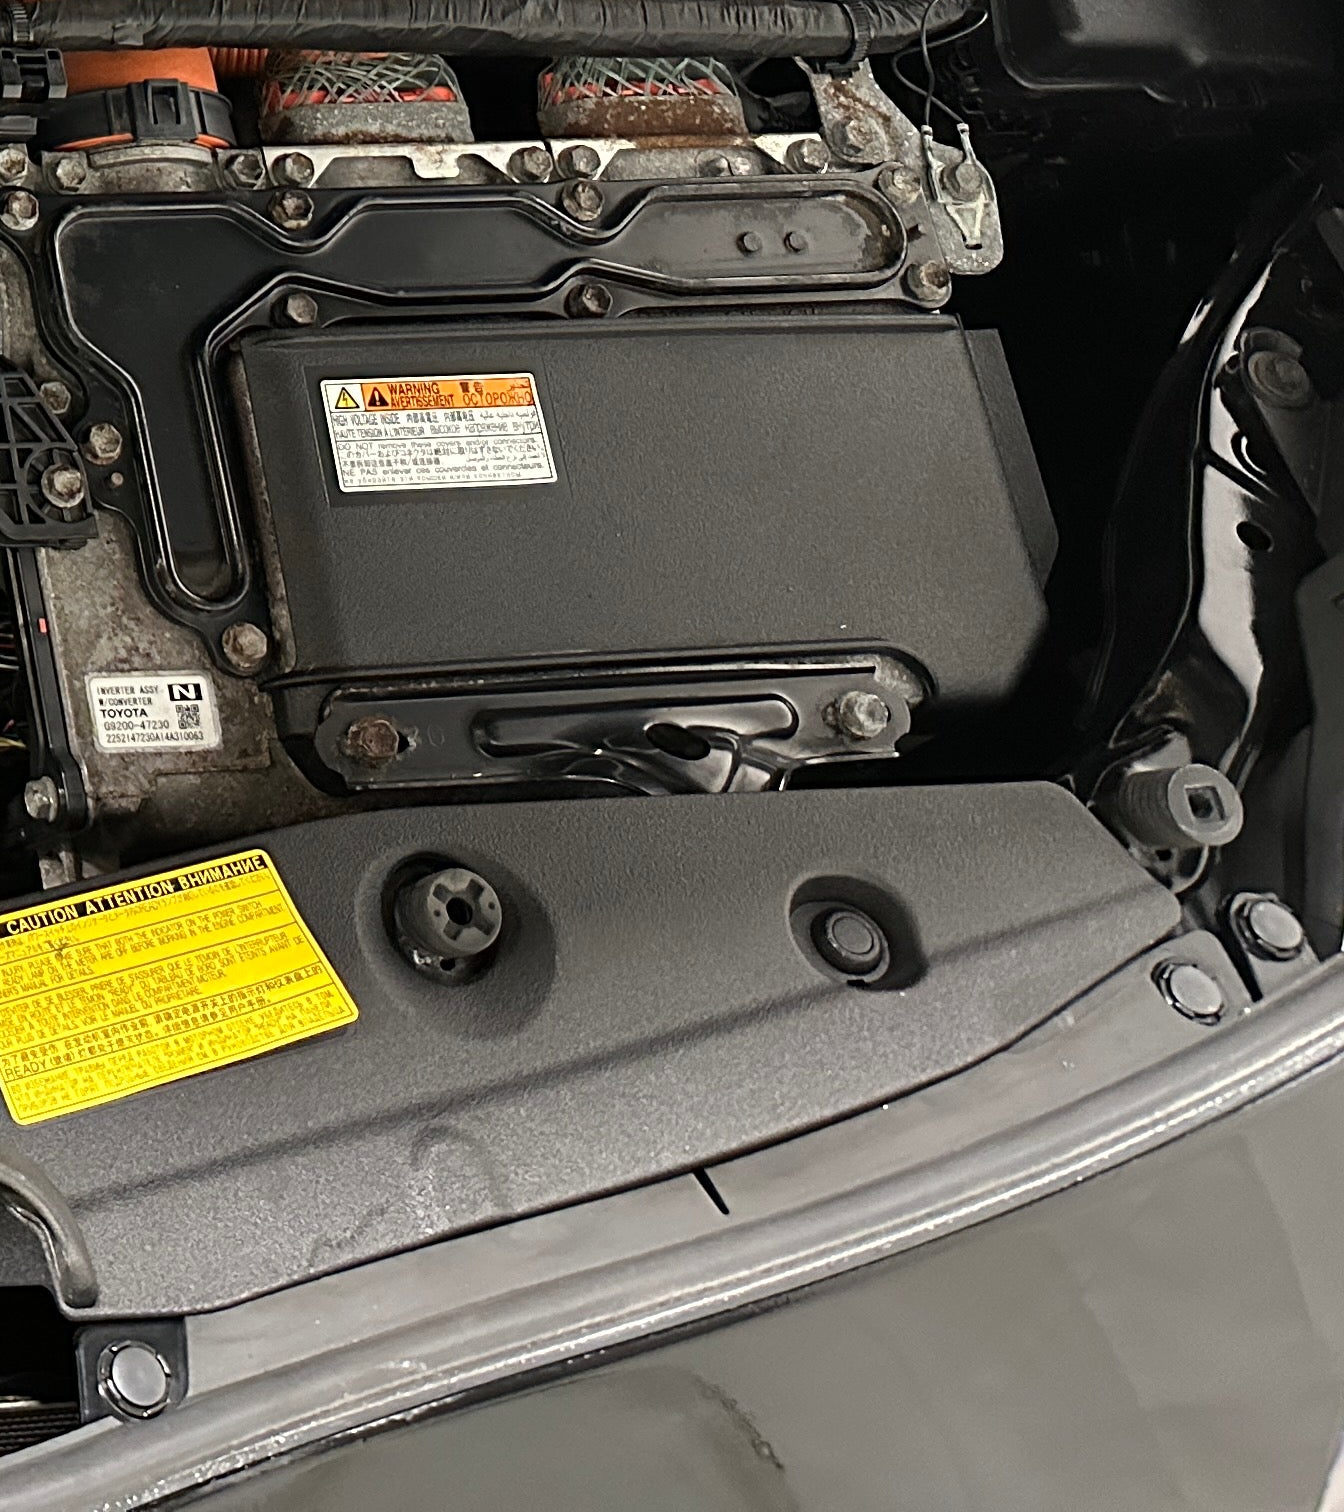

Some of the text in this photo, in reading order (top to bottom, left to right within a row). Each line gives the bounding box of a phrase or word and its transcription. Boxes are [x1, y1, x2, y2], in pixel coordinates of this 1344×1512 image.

[386, 381, 440, 397] WARNING
[388, 393, 457, 409] AVERTISSEMENT
[359, 467, 378, 476] PAS
[95, 684, 159, 695] INVERTER ASSY
[171, 683, 197, 700] N
[97, 696, 153, 707] W/CONVERTER
[98, 707, 149, 719] TOYOTA
[175, 854, 265, 890] ВНИМАНИЕ
[4, 879, 175, 935] CAUTION ATTENTION
